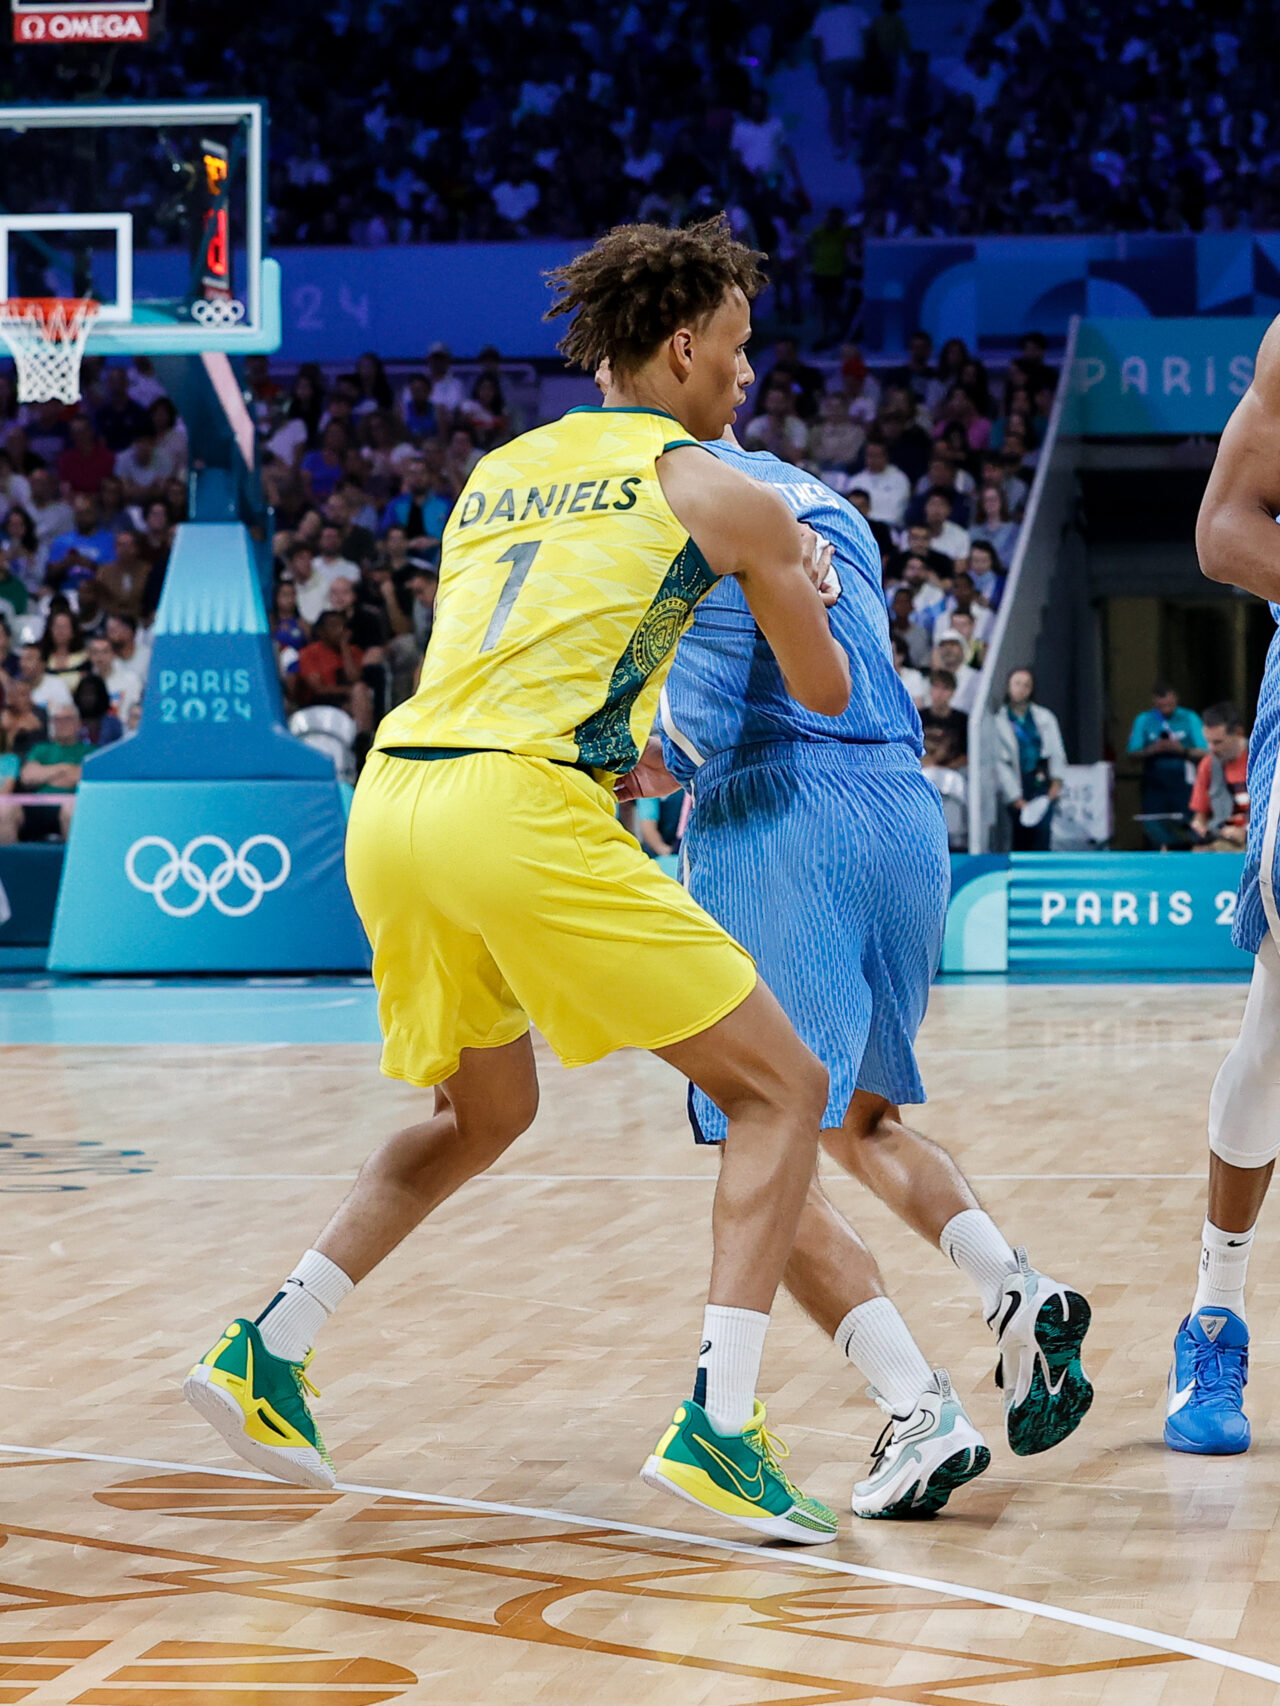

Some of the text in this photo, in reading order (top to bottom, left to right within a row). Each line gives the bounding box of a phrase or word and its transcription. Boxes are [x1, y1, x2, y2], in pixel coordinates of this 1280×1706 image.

[48, 14, 143, 39] OMEGA
[297, 285, 369, 329] 24
[1078, 355, 1255, 396] PARIS
[459, 477, 642, 529] DANIELS
[479, 540, 543, 654] 1
[160, 669, 250, 694] PARIS
[160, 697, 252, 723] 2024
[1041, 890, 1194, 926] PARIS
